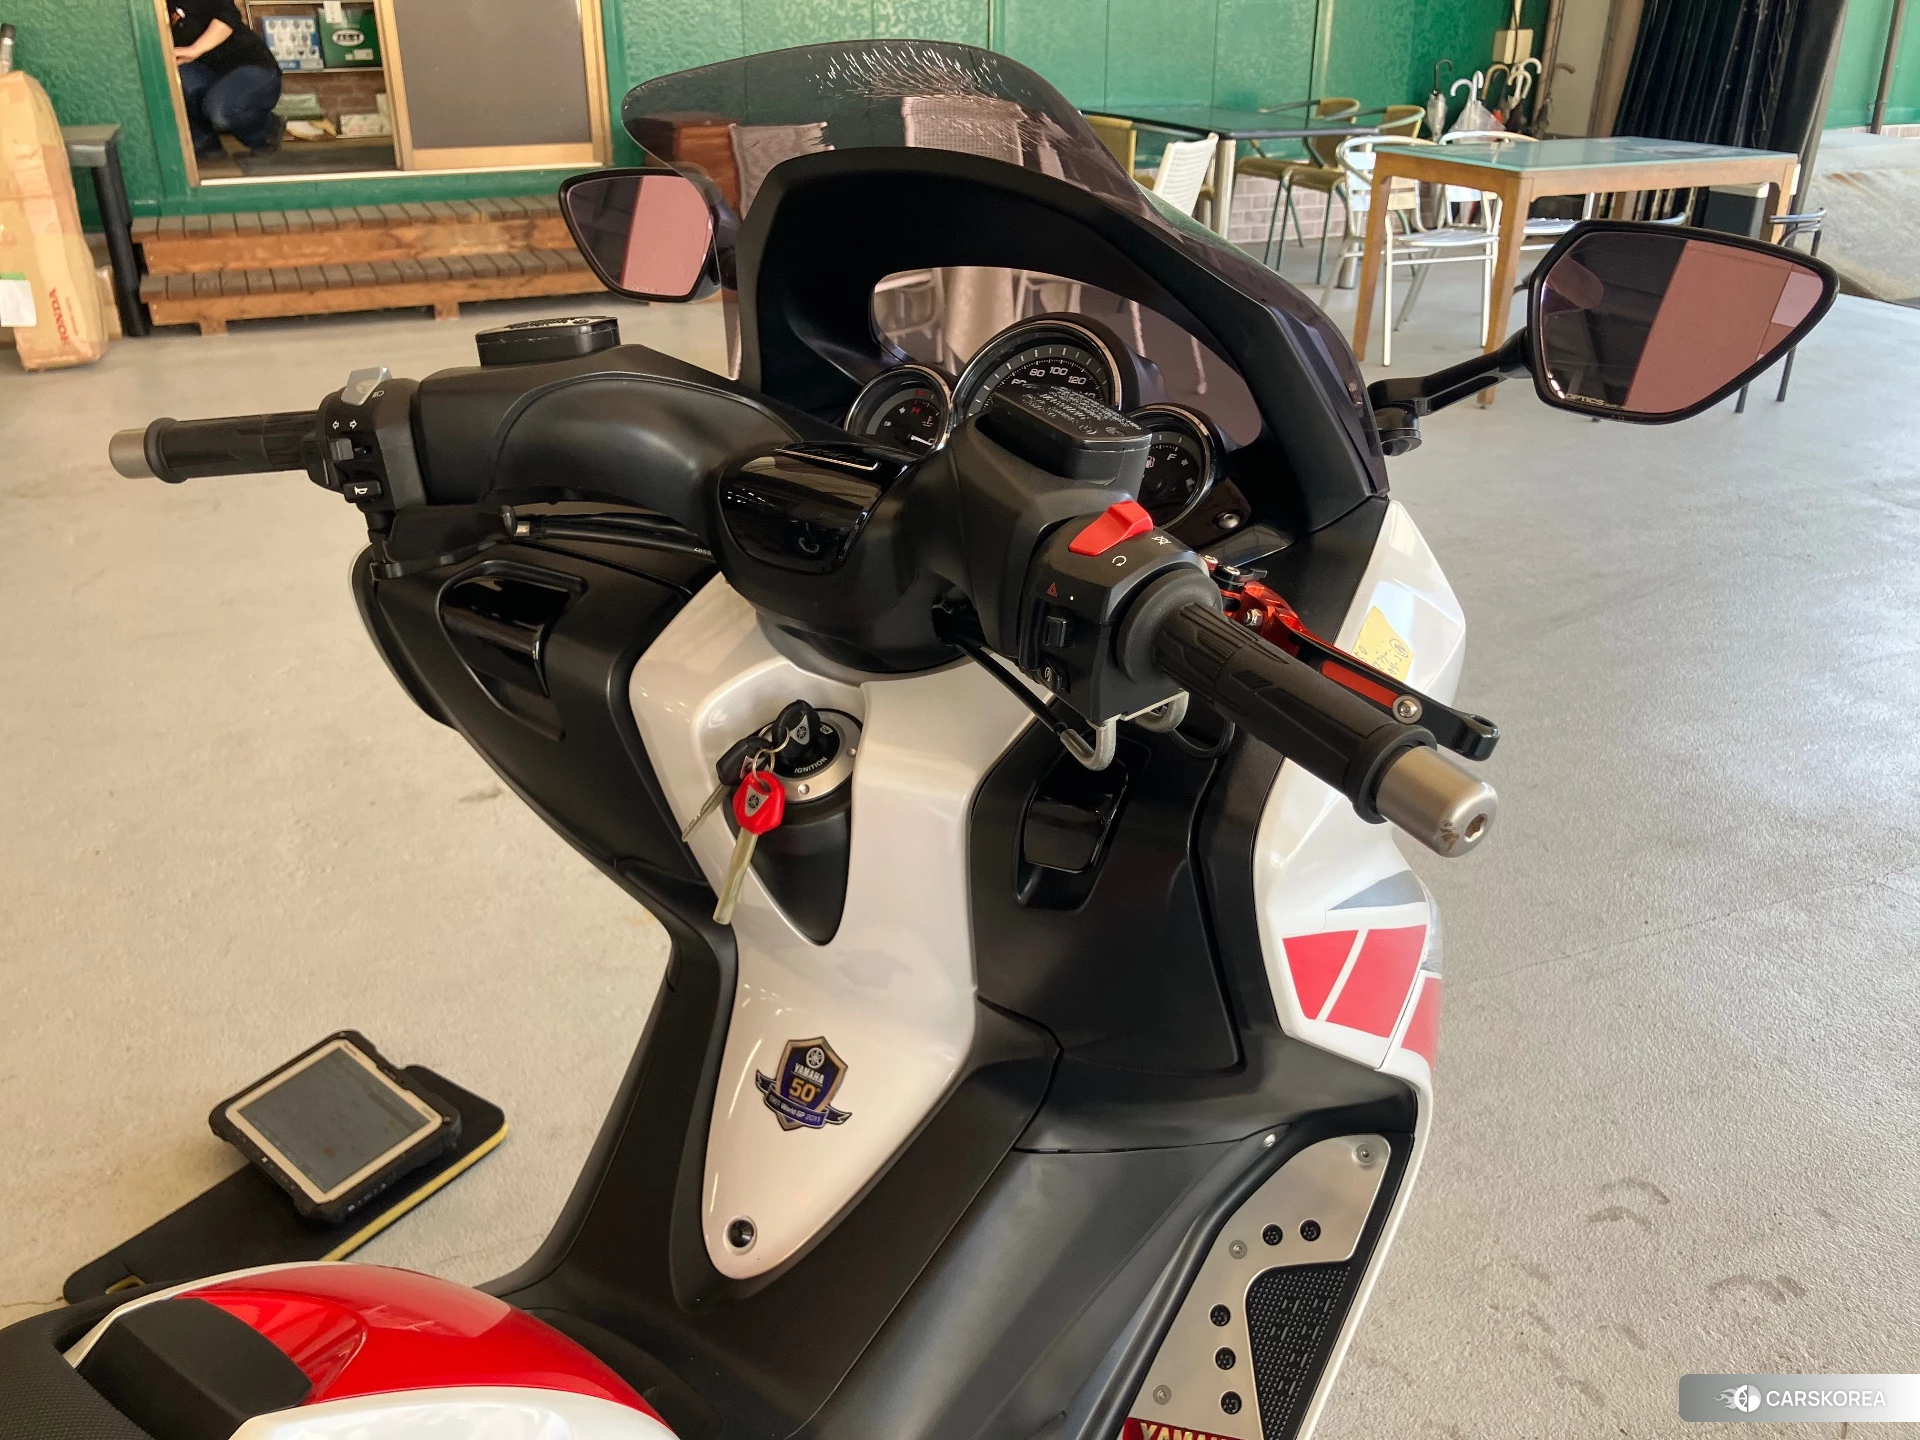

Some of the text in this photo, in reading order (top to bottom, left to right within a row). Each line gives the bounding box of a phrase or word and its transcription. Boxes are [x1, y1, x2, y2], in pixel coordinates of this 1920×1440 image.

[48, 287, 70, 344] HONDA
[1029, 368, 1046, 378] 80
[1049, 366, 1069, 376] 100
[1068, 375, 1087, 385] 120
[1565, 393, 1604, 406] OPTICS
[1166, 453, 1178, 461] F
[794, 756, 828, 774] IGNITION
[793, 1062, 825, 1085] YAMAHA
[780, 1102, 797, 1115] World
